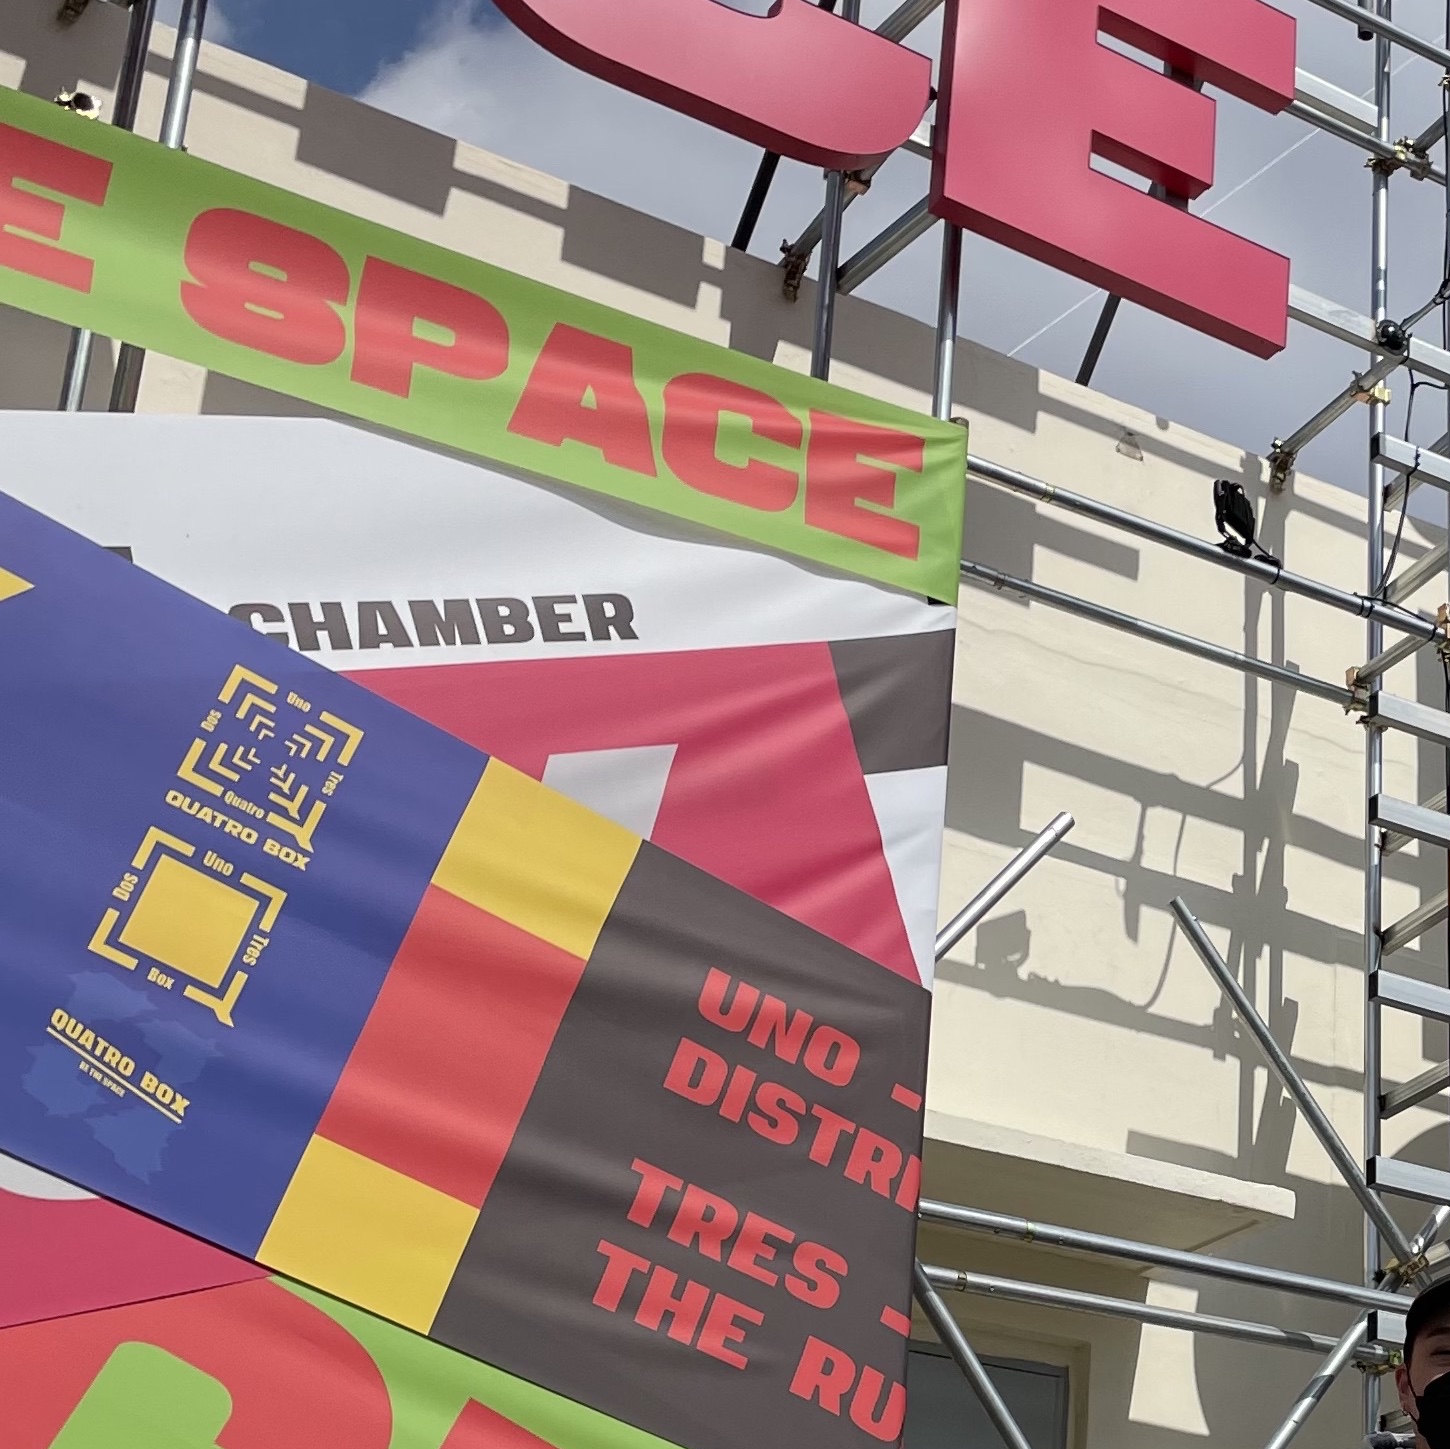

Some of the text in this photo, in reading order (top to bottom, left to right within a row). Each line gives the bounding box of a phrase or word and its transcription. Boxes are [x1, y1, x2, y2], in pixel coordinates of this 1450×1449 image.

[181, 208, 925, 560] SPACE
[287, 692, 311, 712] Uno
[201, 709, 222, 732] Dos
[321, 771, 344, 796] Tres
[224, 791, 265, 819] Quatro
[165, 790, 311, 871] QUATRO BOX
[203, 851, 234, 876] Uno
[112, 872, 139, 901] Dos
[242, 934, 270, 966] Tres
[147, 967, 175, 990] Box
[697, 967, 861, 1087] UNO
[51, 1008, 190, 1117] QUATRO BOX
[626, 1157, 848, 1309] TRES
[591, 1239, 765, 1370] THE
